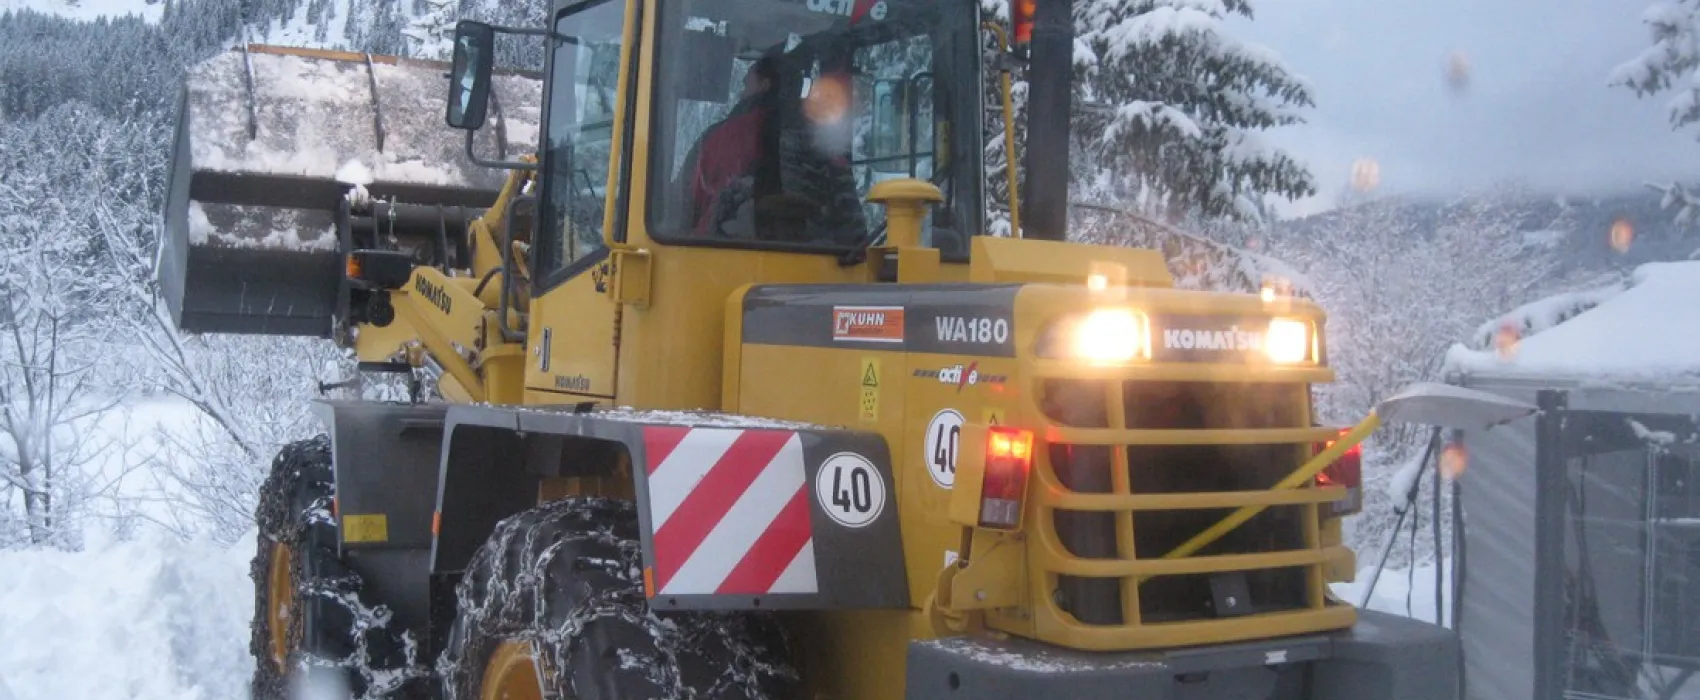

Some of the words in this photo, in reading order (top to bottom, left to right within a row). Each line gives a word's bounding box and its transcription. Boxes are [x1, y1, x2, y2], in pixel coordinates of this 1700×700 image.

[415, 272, 452, 315] KOMATSU
[849, 311, 885, 326] KUHN
[935, 316, 1009, 344] WA180
[554, 373, 591, 391] KOMATSU
[832, 466, 872, 513] 40
